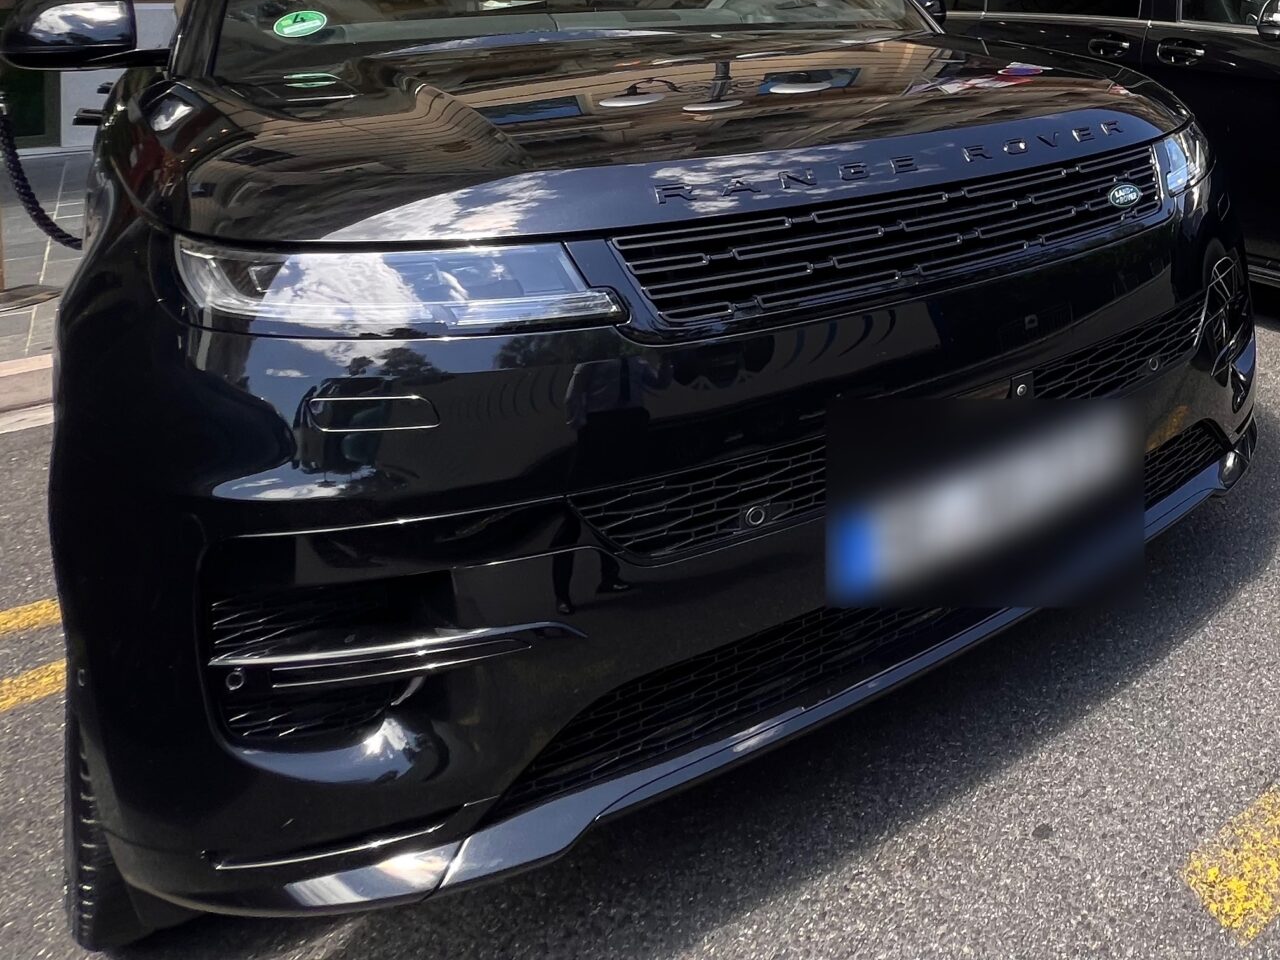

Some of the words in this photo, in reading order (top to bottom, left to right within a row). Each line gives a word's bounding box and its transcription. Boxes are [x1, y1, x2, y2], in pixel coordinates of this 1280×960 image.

[292, 13, 306, 24] 4
[654, 155, 919, 204] RANGE
[961, 120, 1124, 163] ROVER
